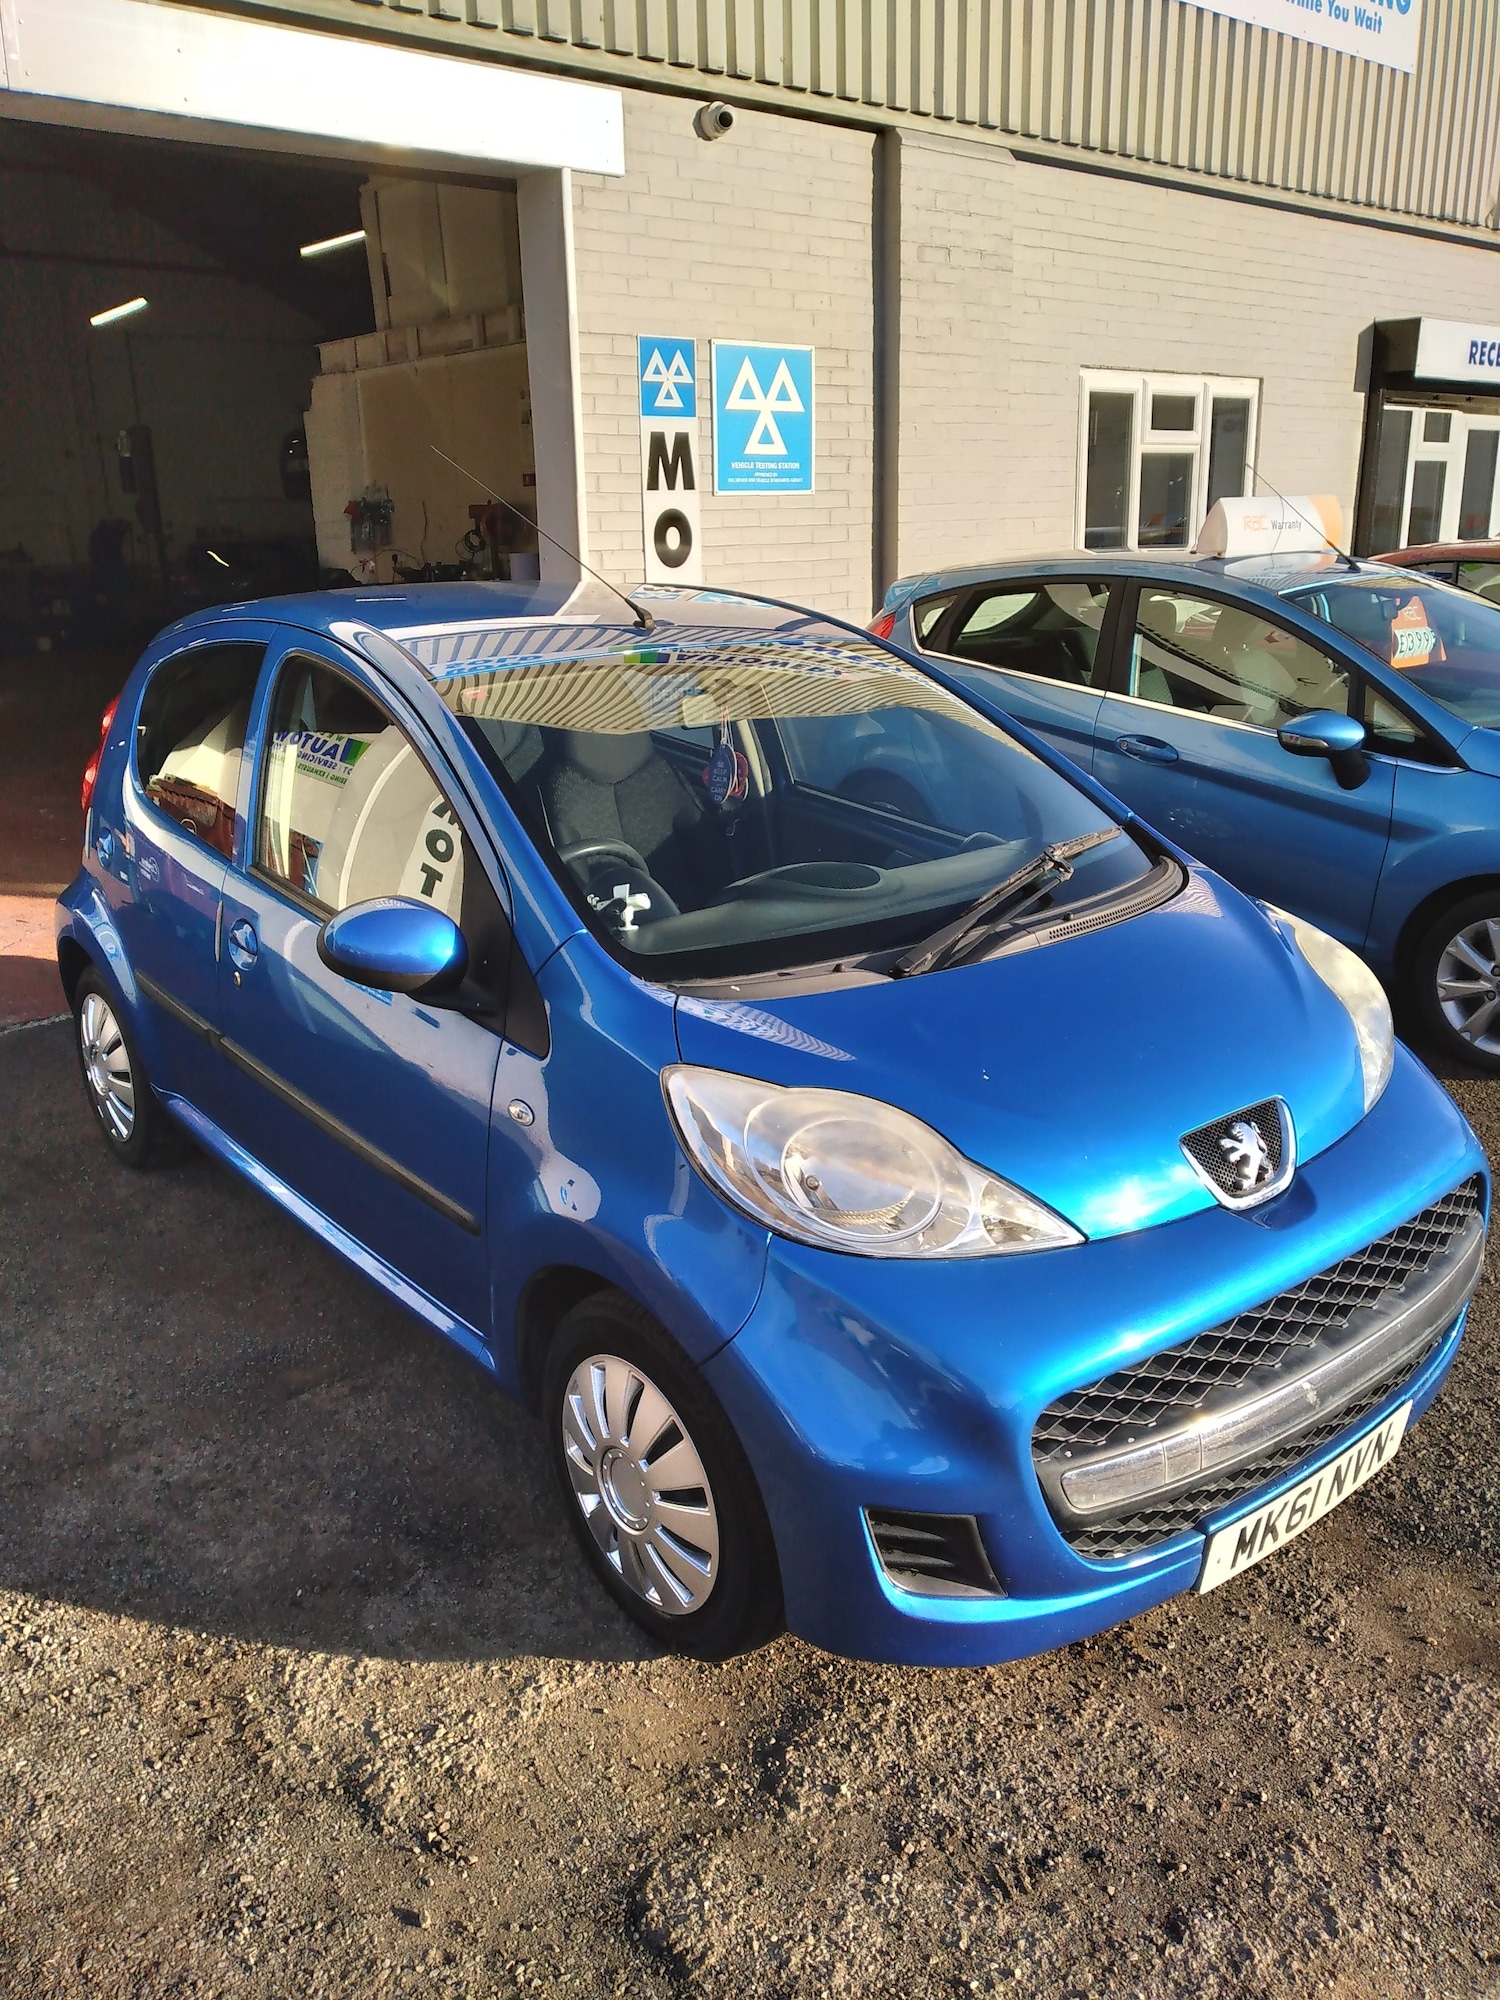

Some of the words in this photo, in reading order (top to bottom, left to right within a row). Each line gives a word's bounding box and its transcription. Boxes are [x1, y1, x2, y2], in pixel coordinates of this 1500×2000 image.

[1328, 0, 1350, 22] You
[1354, 5, 1382, 34] Wait
[731, 461, 755, 469] VEHICLE
[1271, 519, 1302, 531] Warranty
[1230, 1477, 1324, 1570] MK61
[1325, 1422, 1393, 1507] NVN
